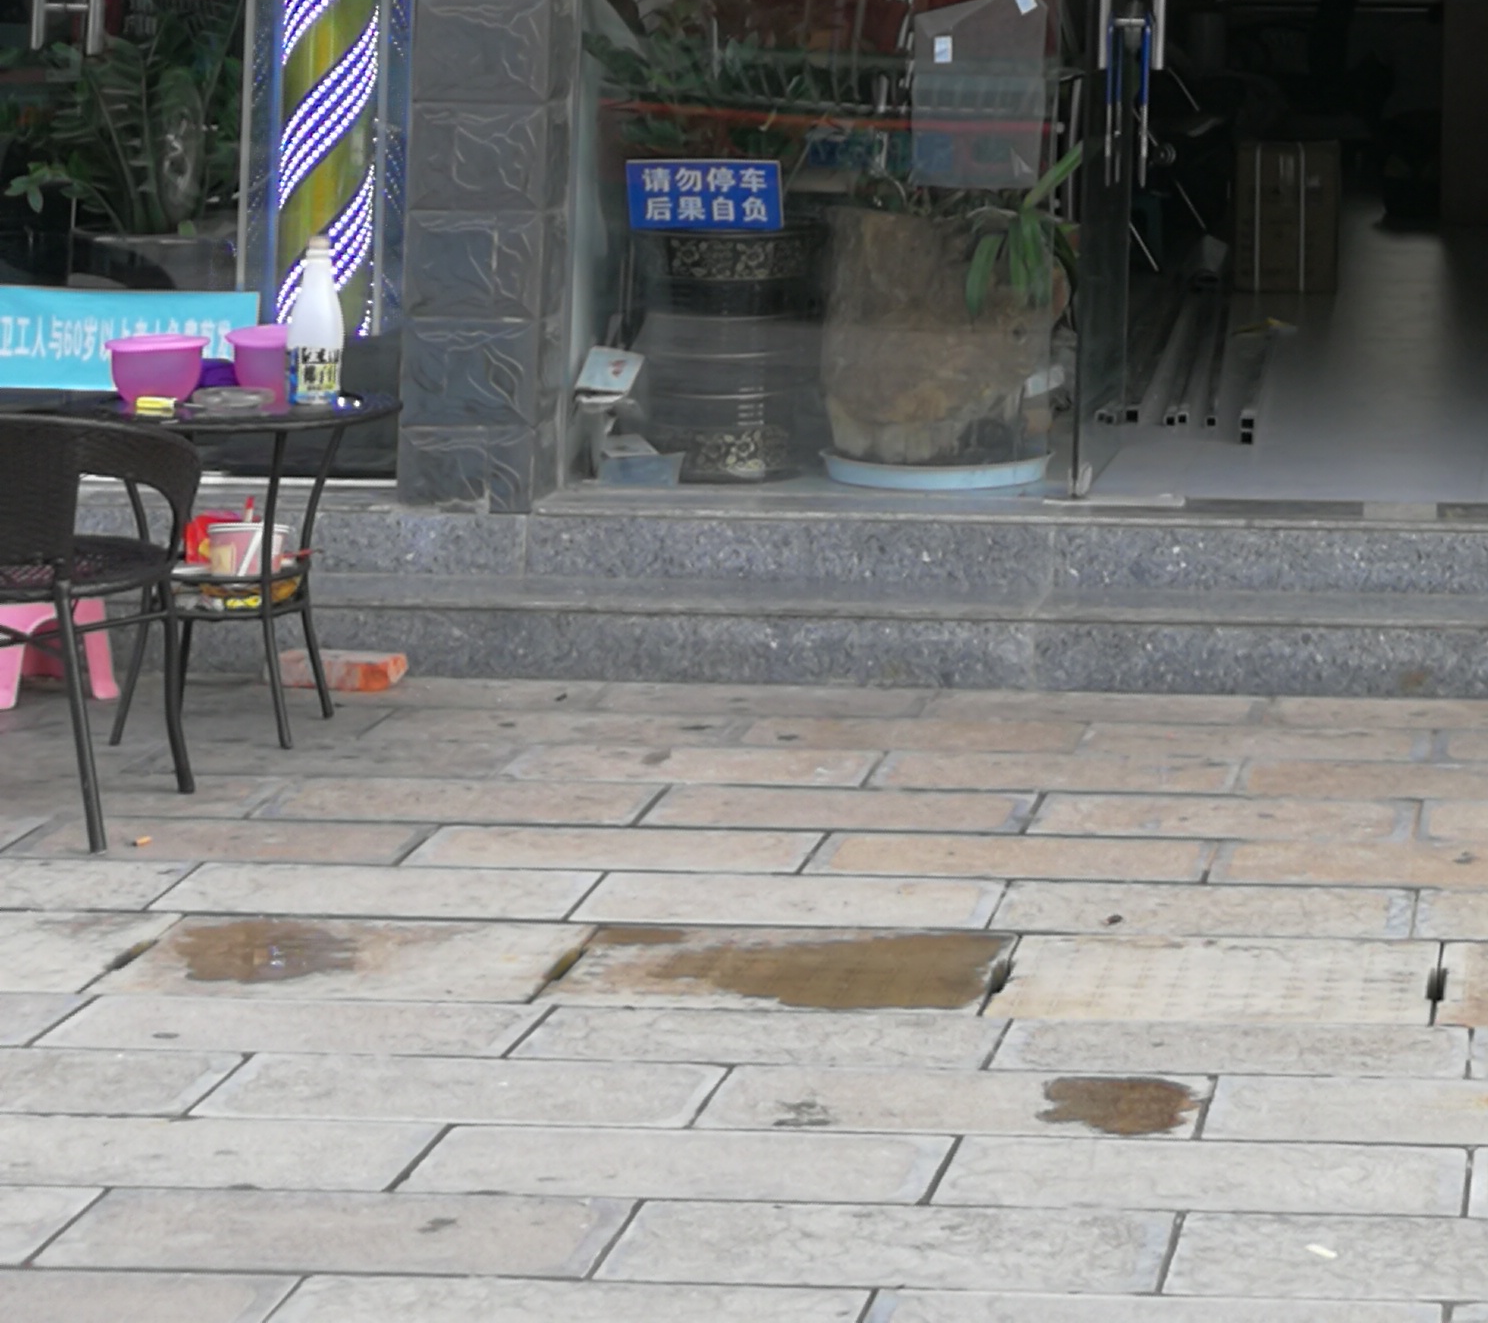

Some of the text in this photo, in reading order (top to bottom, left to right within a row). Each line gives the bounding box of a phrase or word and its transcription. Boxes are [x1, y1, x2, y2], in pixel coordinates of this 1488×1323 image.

[641, 166, 769, 194] 请勿停车
[644, 196, 770, 223] 后果自负
